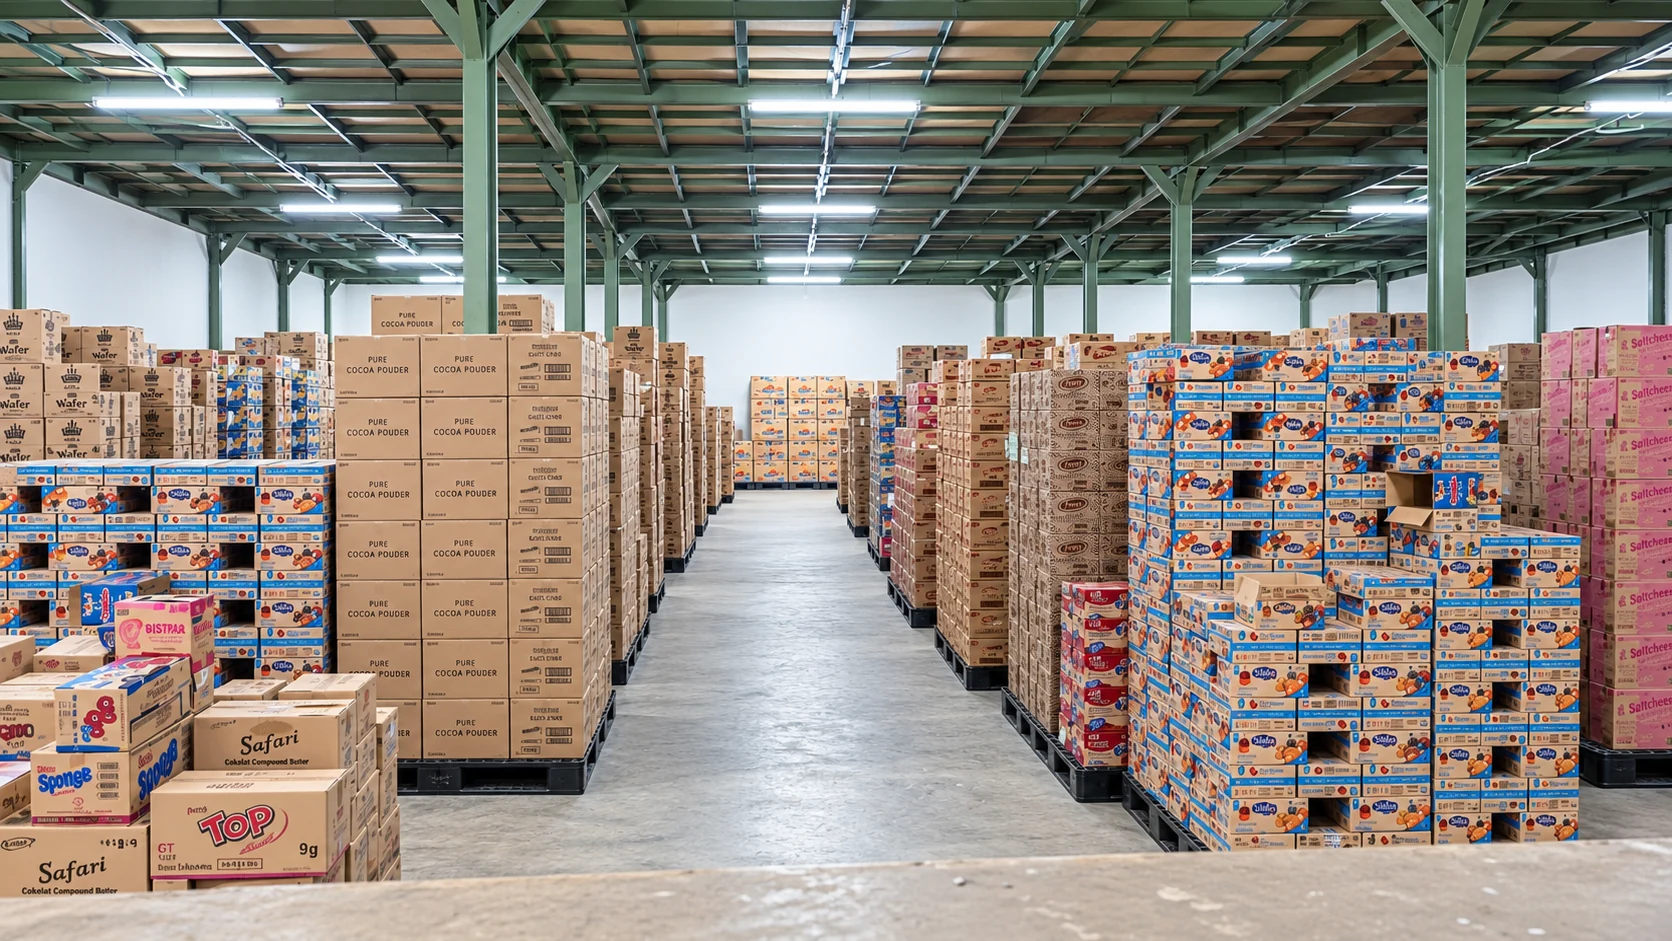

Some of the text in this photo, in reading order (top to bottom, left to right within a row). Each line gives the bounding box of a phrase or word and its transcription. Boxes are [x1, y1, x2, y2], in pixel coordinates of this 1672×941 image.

[240, 730, 299, 755] Safari
[158, 843, 174, 853] GT
[299, 843, 318, 858] 9g
[39, 856, 107, 884] Safari
